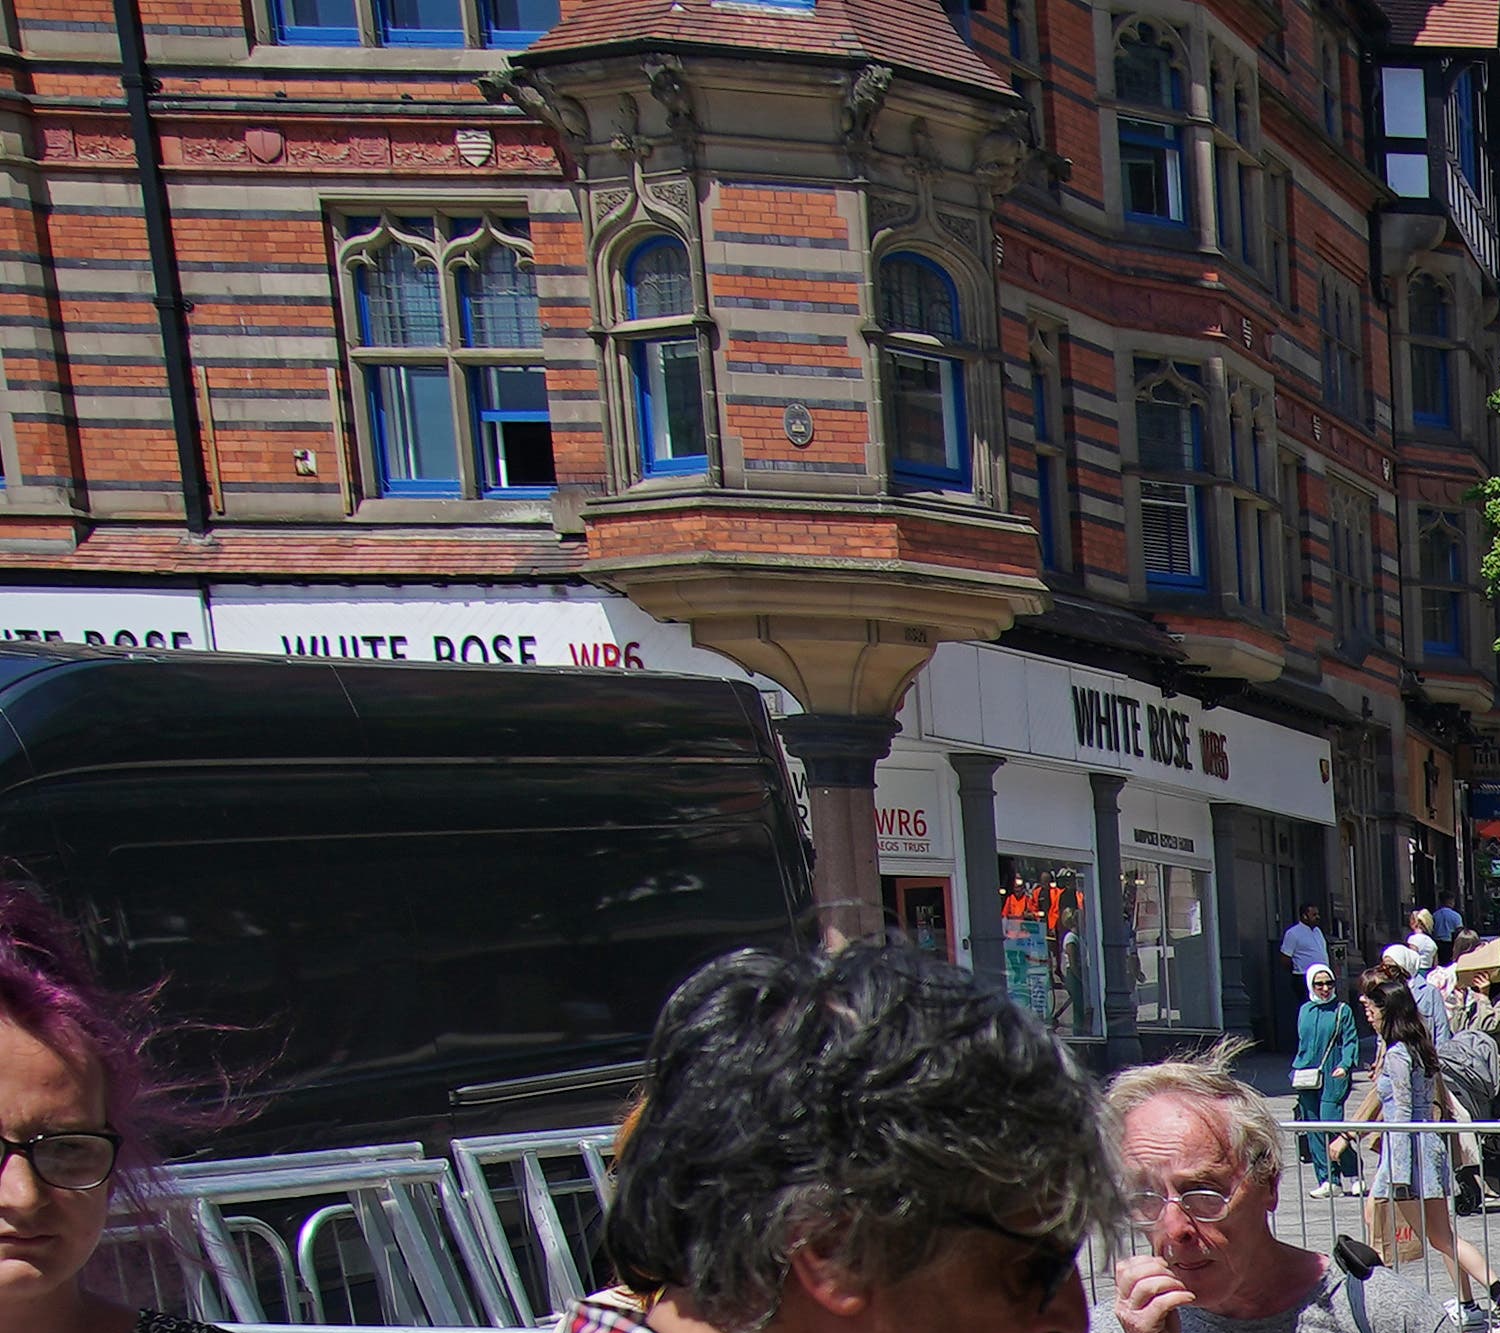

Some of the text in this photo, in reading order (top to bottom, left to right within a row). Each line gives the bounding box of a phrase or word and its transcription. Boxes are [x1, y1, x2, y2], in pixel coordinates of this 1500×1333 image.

[1072, 685, 1230, 781] WHITE ROSE WR6
[874, 808, 928, 837] WR6
[904, 842, 930, 853] TRUST
